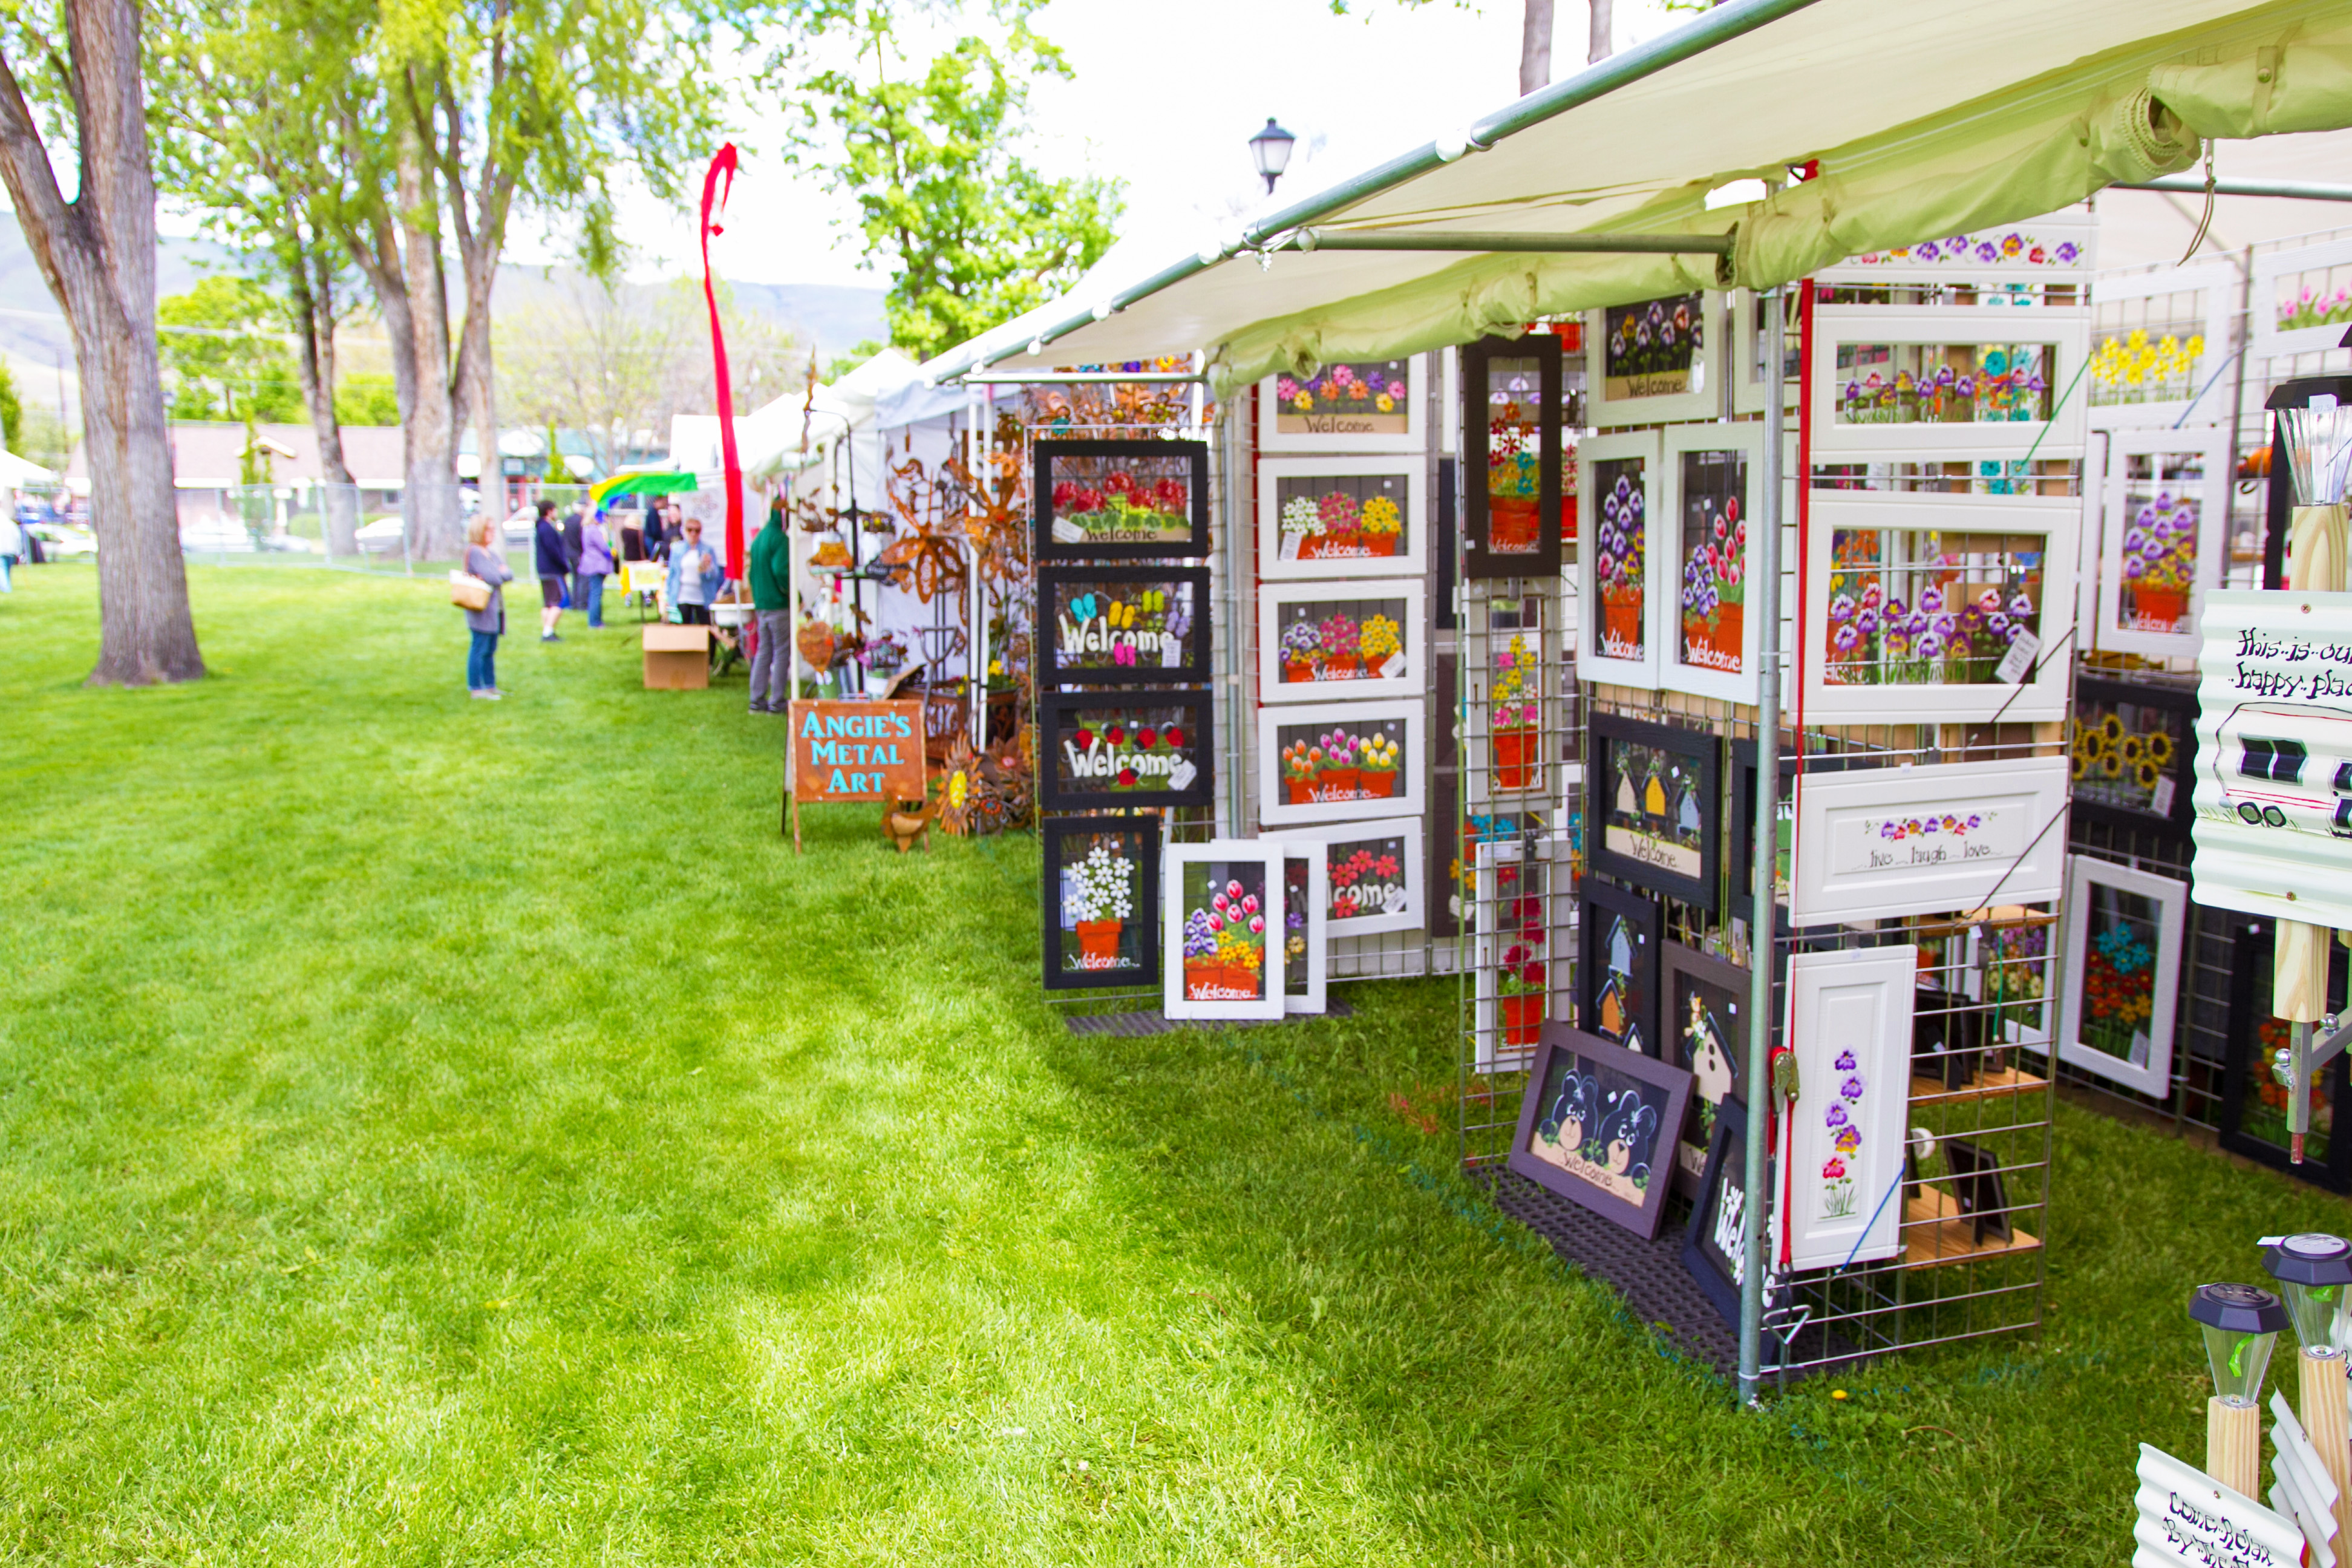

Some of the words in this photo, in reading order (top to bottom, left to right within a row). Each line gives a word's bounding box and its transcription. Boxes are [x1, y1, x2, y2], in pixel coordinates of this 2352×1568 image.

[1059, 613, 1175, 653] Welcome
[2236, 627, 2282, 659] This
[2285, 636, 2310, 661] is
[1685, 635, 1740, 671] Welcome
[2235, 661, 2304, 697] happy
[2306, 670, 2352, 699] plac
[800, 711, 912, 738] ANGIE'S
[811, 740, 904, 765] METAL
[1063, 737, 1182, 777] Welcome
[828, 768, 886, 793] ART
[1869, 850, 1893, 867] live
[1911, 844, 1946, 865] laugh
[1964, 841, 1991, 858] love
[1189, 982, 1252, 999] Welcome
[2169, 1491, 2218, 1533] Come
[2219, 1516, 2274, 1566] Relax
